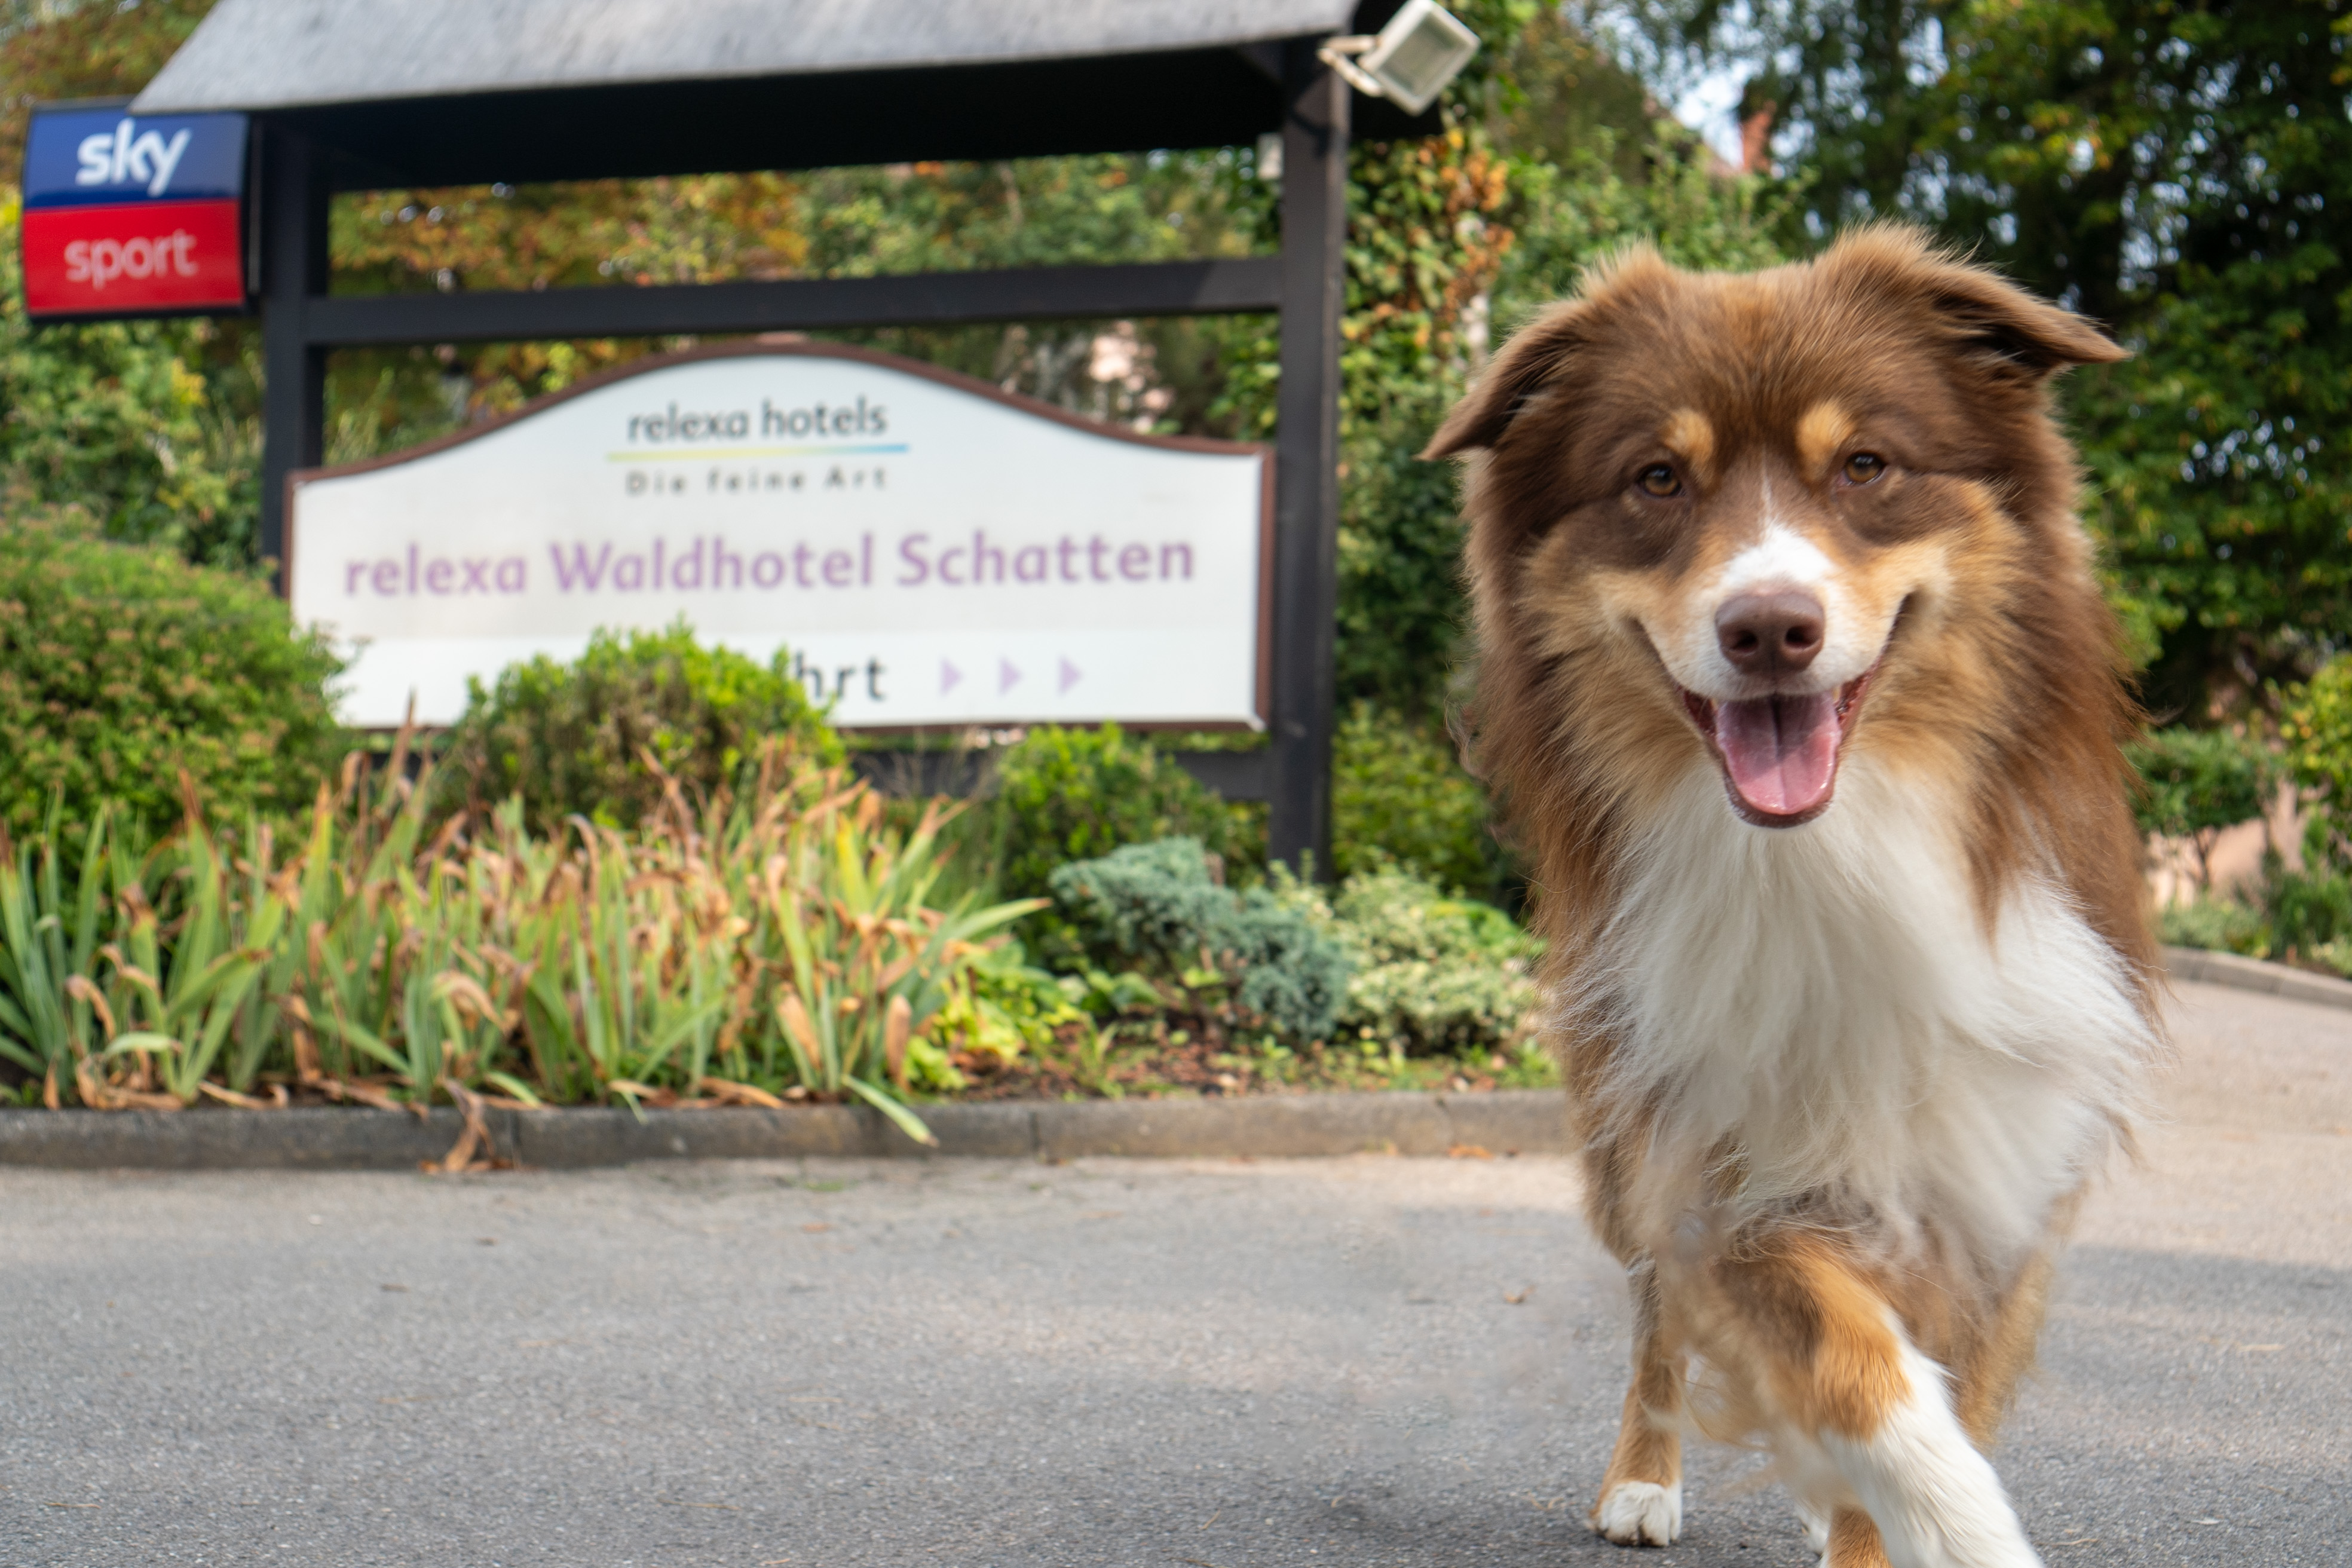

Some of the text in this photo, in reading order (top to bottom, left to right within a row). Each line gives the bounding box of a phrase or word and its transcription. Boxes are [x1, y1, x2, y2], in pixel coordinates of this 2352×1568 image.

[75, 117, 193, 198] sky
[64, 228, 199, 290] sport
[627, 396, 888, 442] relexa hotels
[625, 466, 886, 497] Die feine Art
[345, 528, 1195, 598] relexa Waldhotel Schatten
[795, 651, 887, 703] hrt
